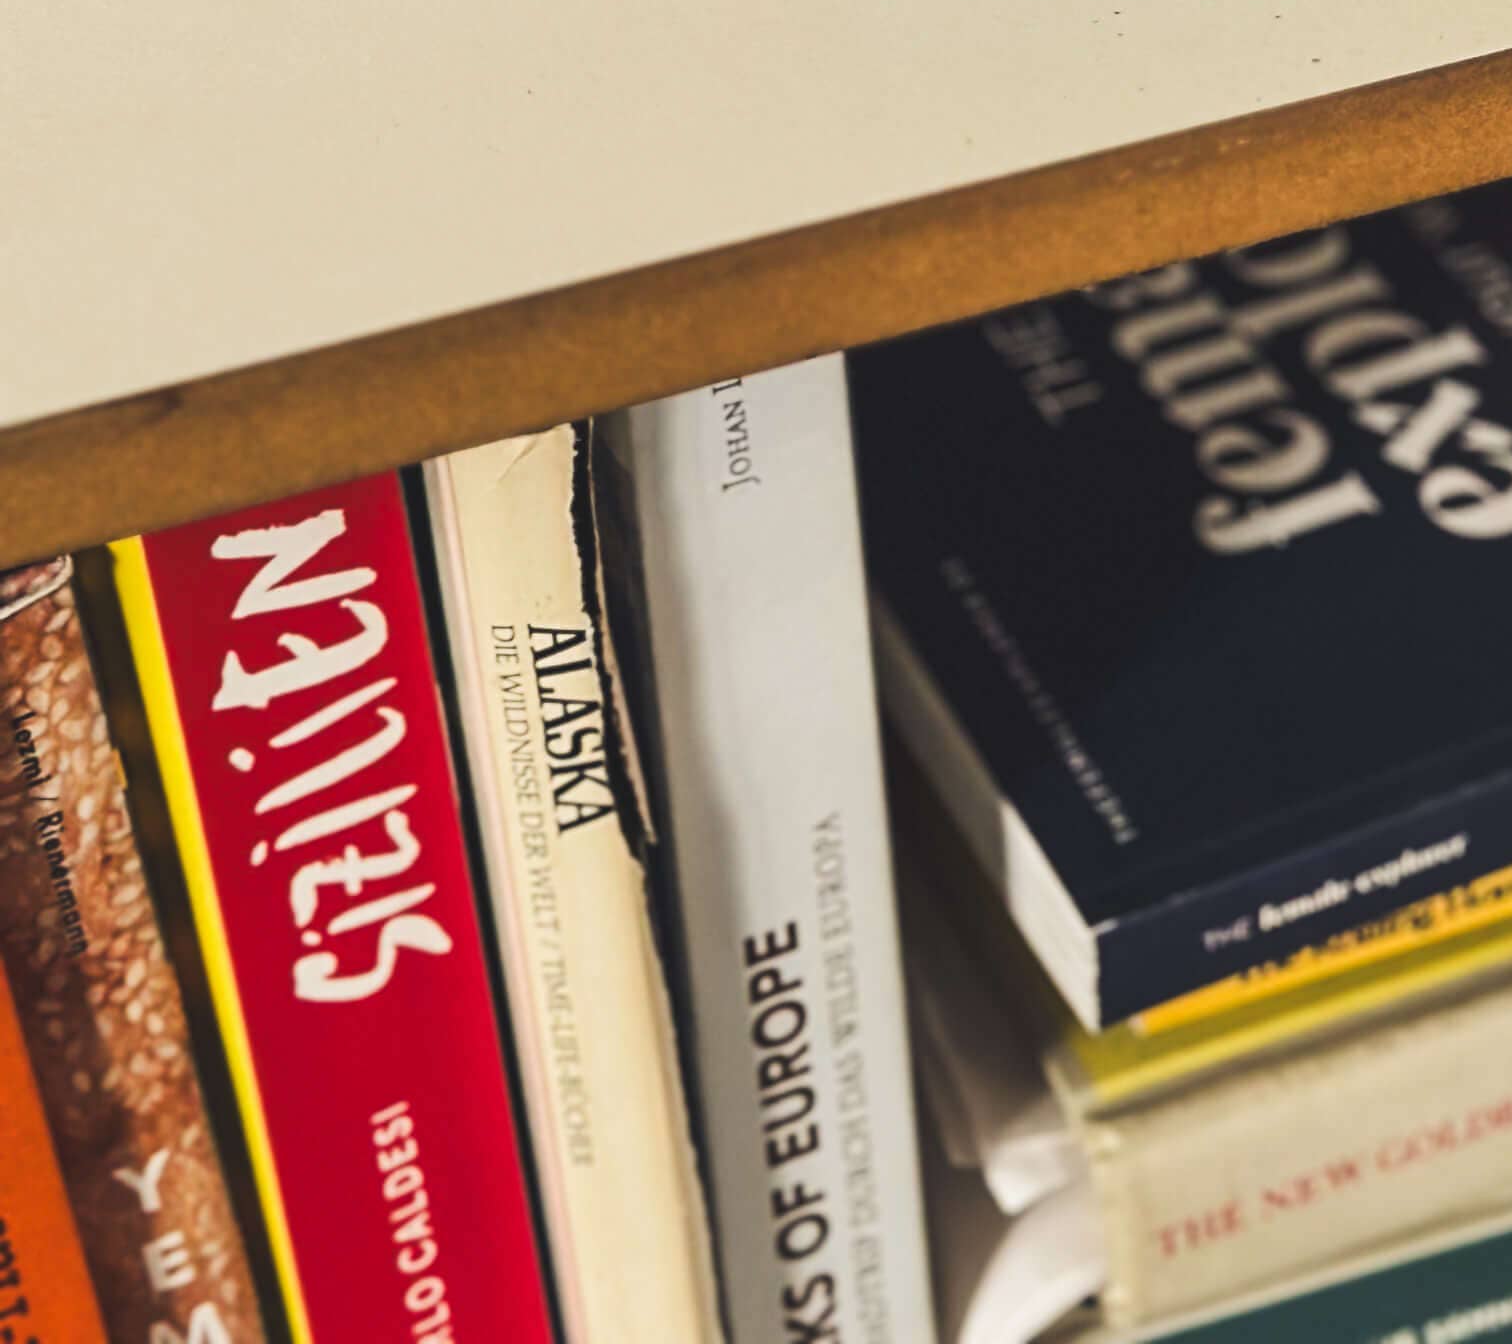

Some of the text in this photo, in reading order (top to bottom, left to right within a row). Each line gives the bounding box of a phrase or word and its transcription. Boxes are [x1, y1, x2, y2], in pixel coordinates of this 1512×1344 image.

[722, 399, 761, 491] JOHAN
[491, 624, 518, 664] DIE
[498, 671, 541, 808] WILDNISSE
[528, 624, 617, 837] ALASKA
[519, 809, 550, 859] DER
[527, 863, 562, 935] WELT
[744, 921, 821, 1170] EUROPE
[771, 1182, 832, 1262] OF
